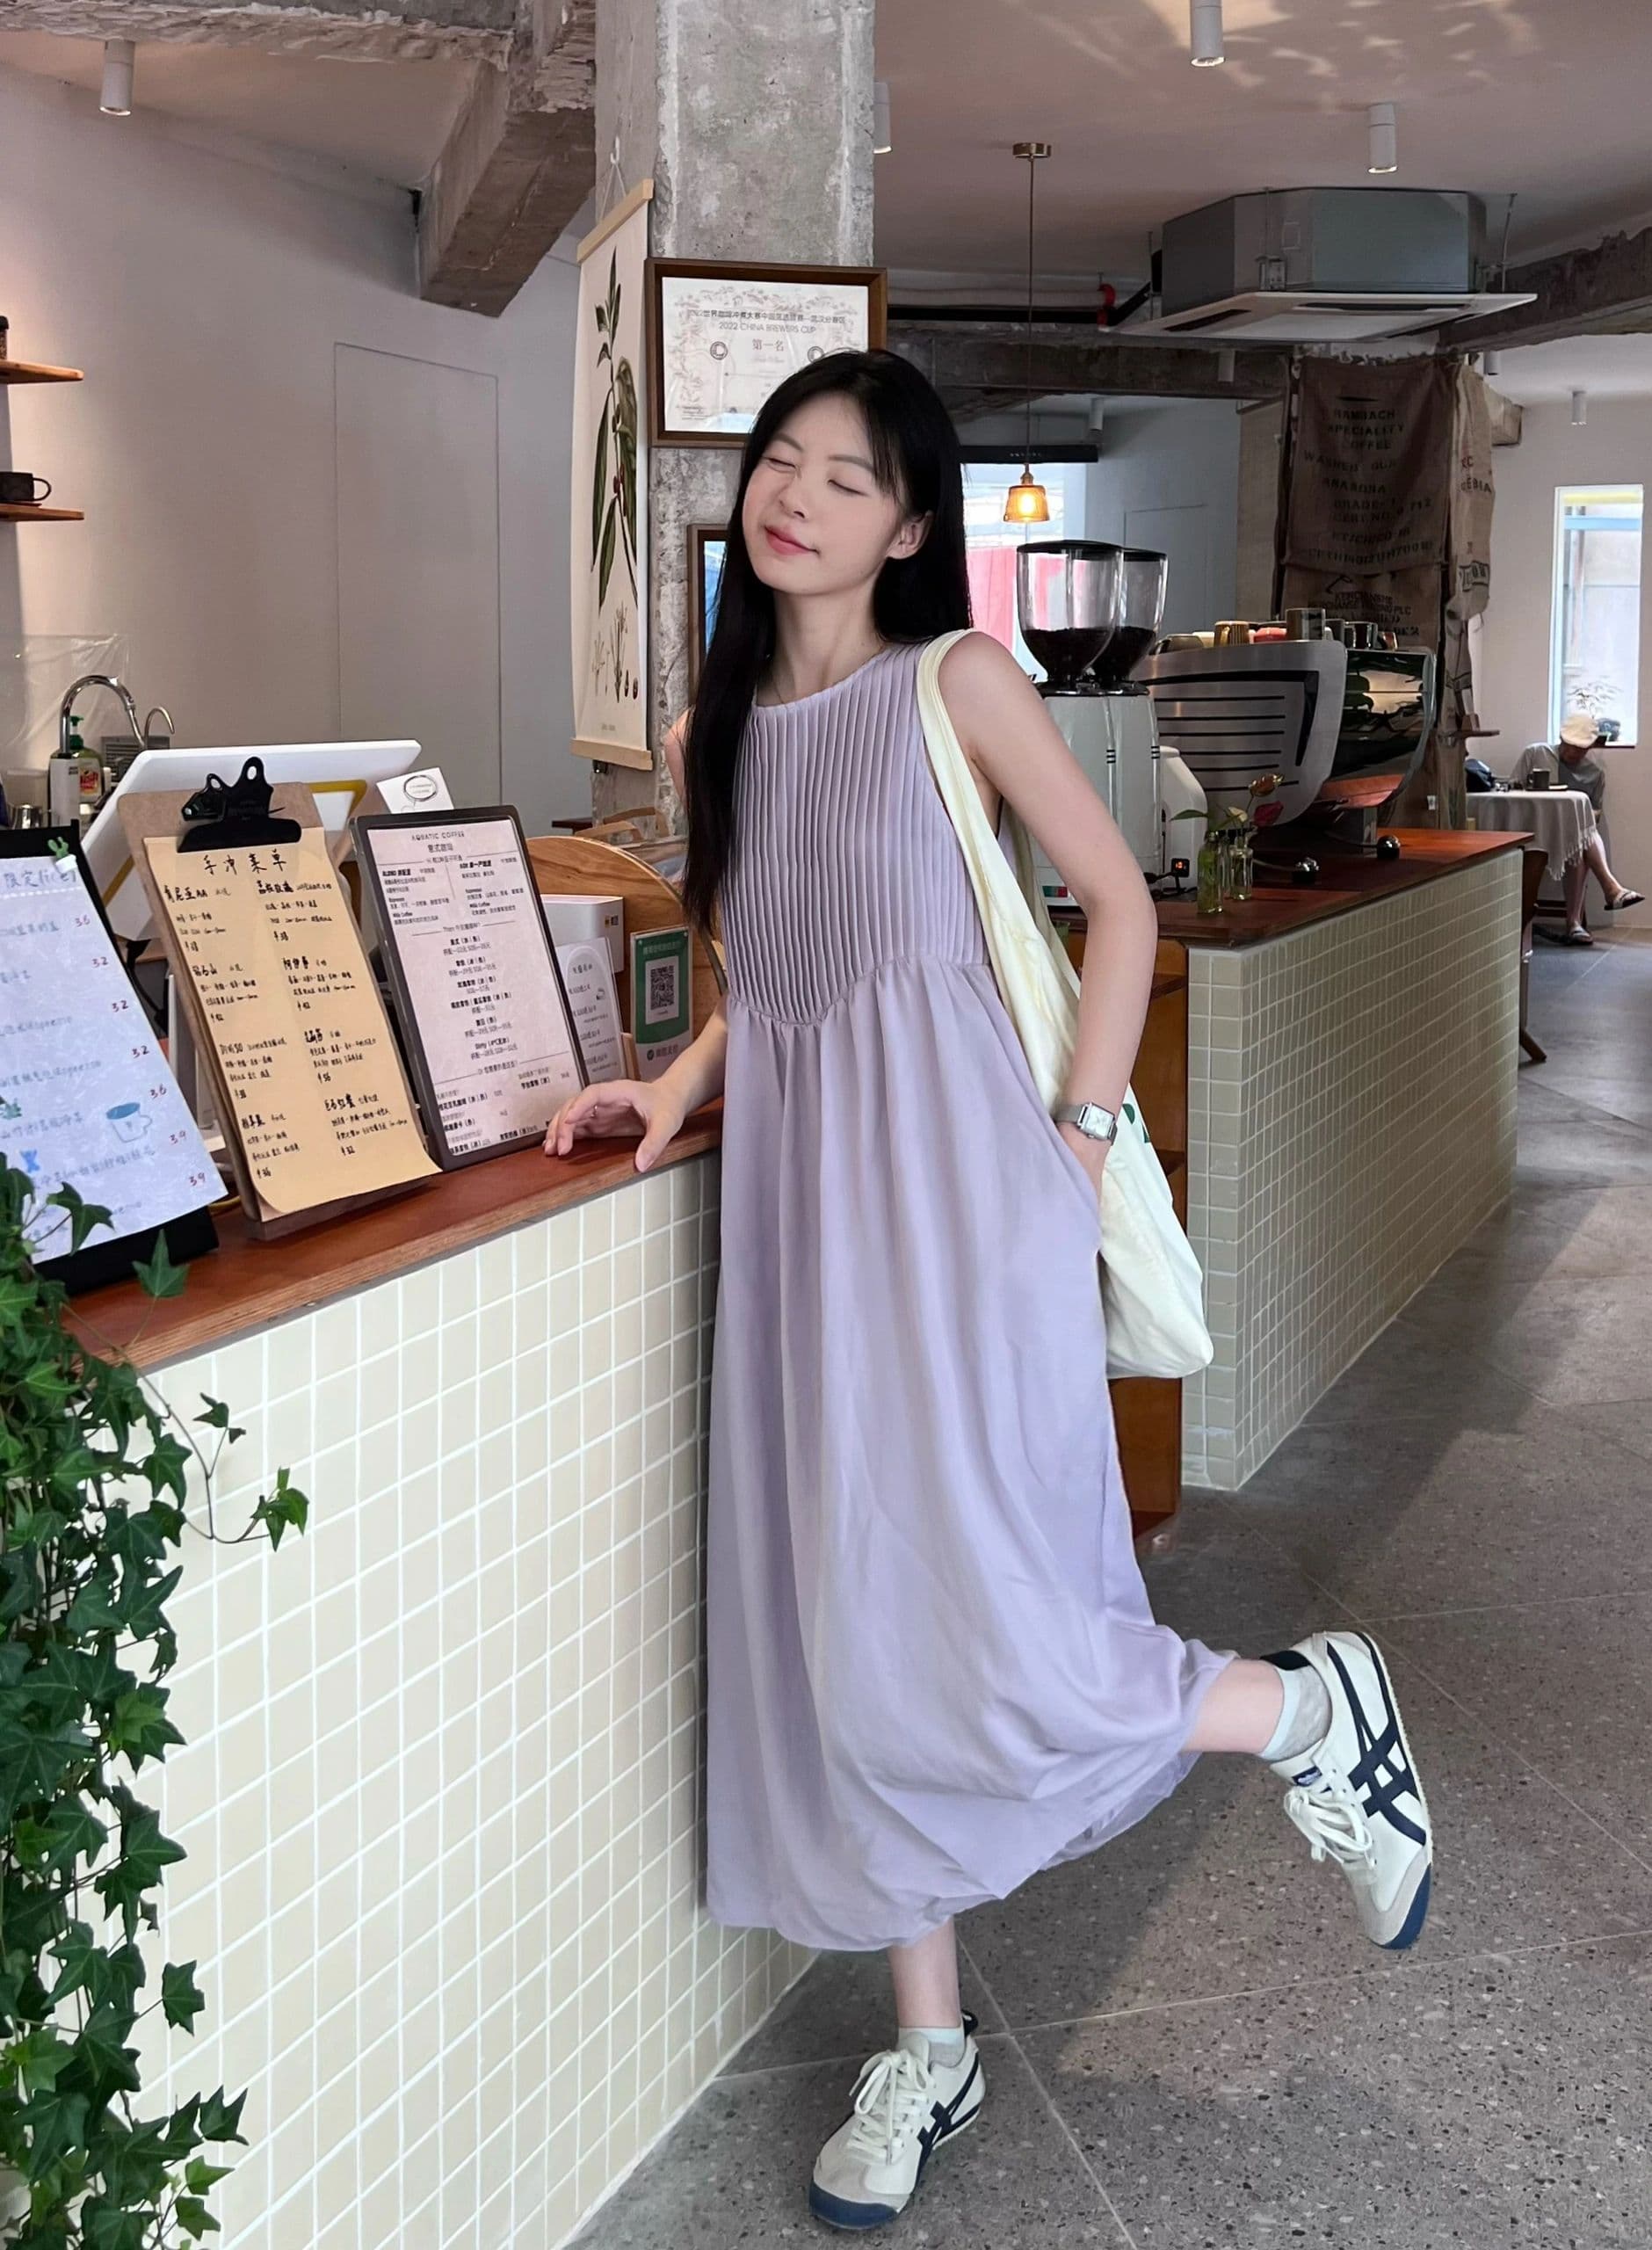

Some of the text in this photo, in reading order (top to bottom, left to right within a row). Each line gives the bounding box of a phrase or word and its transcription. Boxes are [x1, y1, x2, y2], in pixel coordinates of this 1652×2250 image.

[719, 322, 738, 330] 2022
[740, 323, 764, 331] CHINA
[801, 325, 816, 334] CUP
[752, 338, 785, 352] 第一名
[203, 848, 287, 875] 手冲菜单
[92, 956, 108, 968] 32
[112, 999, 129, 1012] 32
[132, 1045, 150, 1059] 32
[169, 1130, 186, 1144] 39
[188, 1172, 206, 1187] 39
